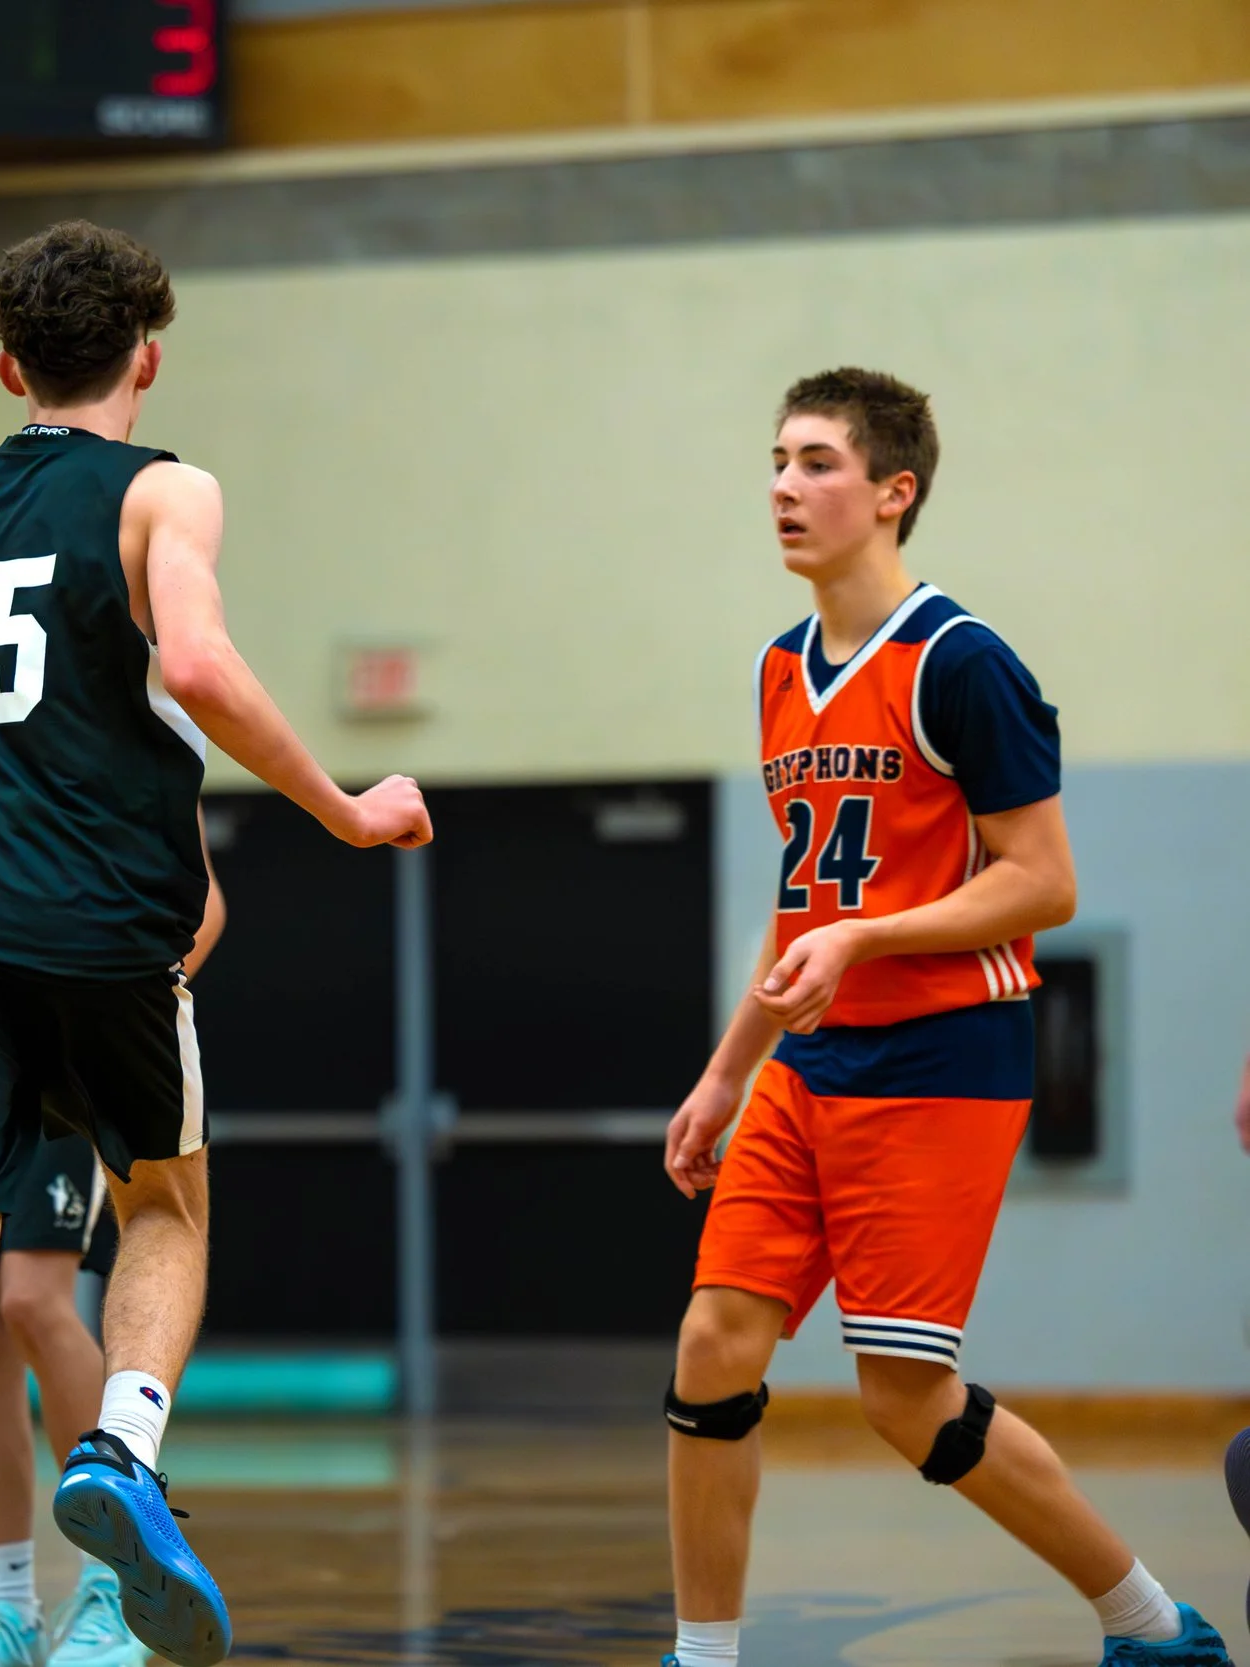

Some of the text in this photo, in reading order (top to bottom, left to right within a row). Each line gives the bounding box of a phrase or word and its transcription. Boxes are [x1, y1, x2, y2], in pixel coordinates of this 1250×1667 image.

[152, 0, 217, 96] 3
[37, 426, 70, 436] PRO
[776, 795, 882, 913] 24
